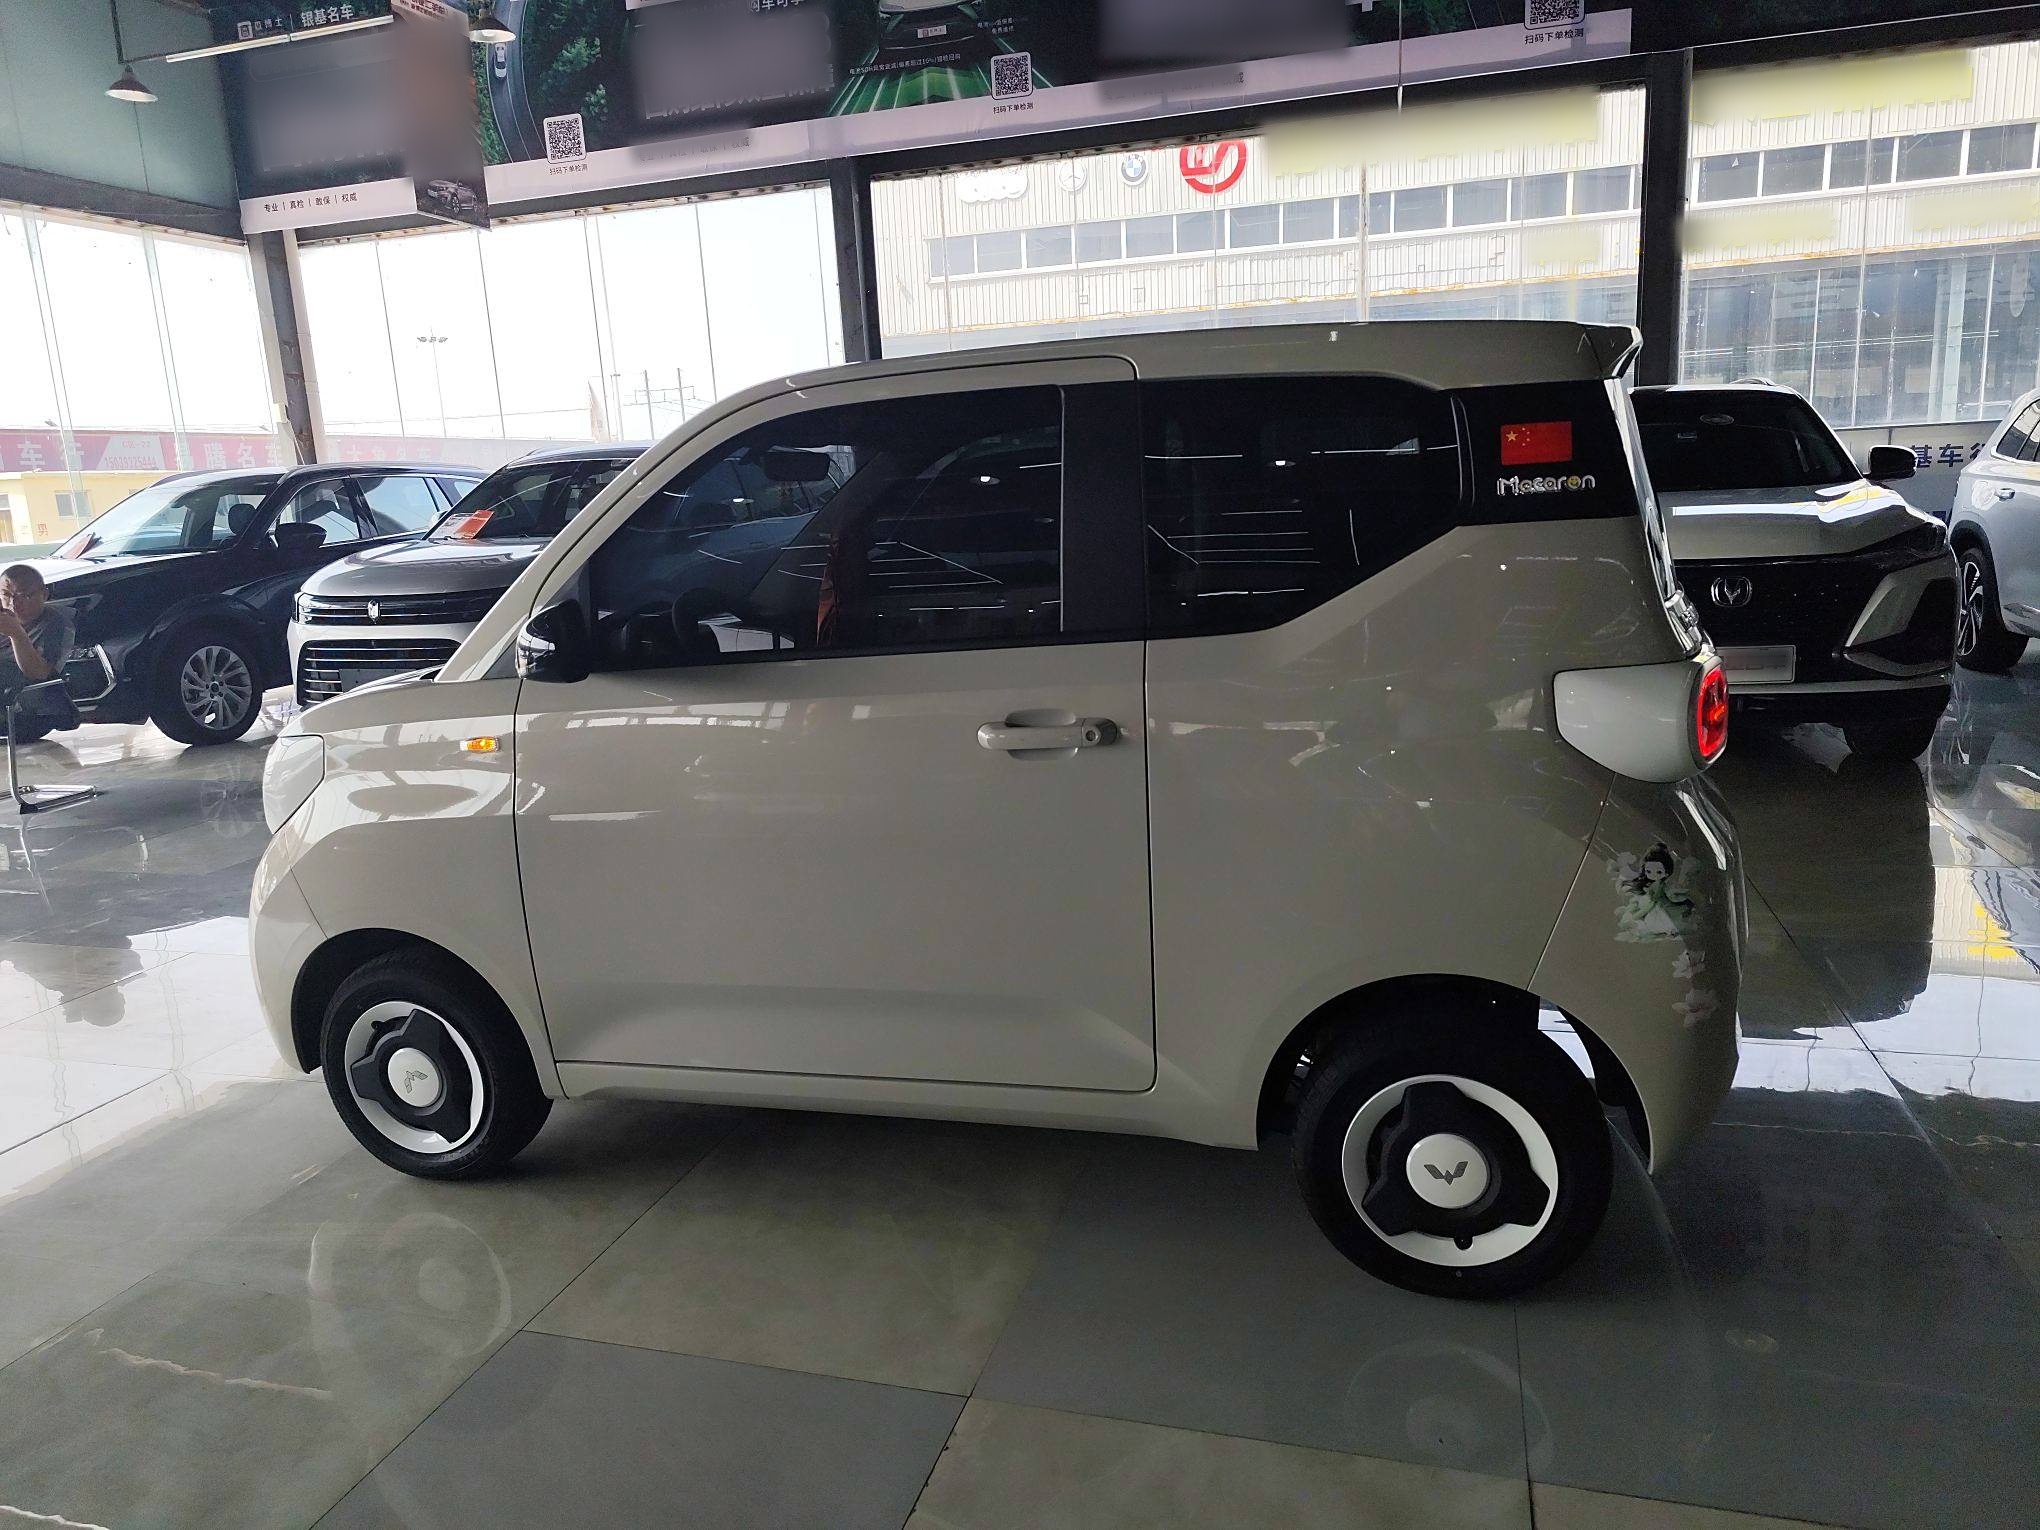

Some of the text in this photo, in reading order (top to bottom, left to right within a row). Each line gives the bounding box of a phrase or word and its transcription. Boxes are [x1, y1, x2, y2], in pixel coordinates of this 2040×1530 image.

[301, 4, 355, 28] 银基名车
[1524, 28, 1584, 44] 扫码下单检测
[993, 102, 1034, 114] 扫码下单检测
[549, 163, 588, 175] 扫码下单检测
[264, 203, 279, 213] 专业
[341, 192, 358, 203] 权威
[1497, 475, 1596, 496] Macaron
